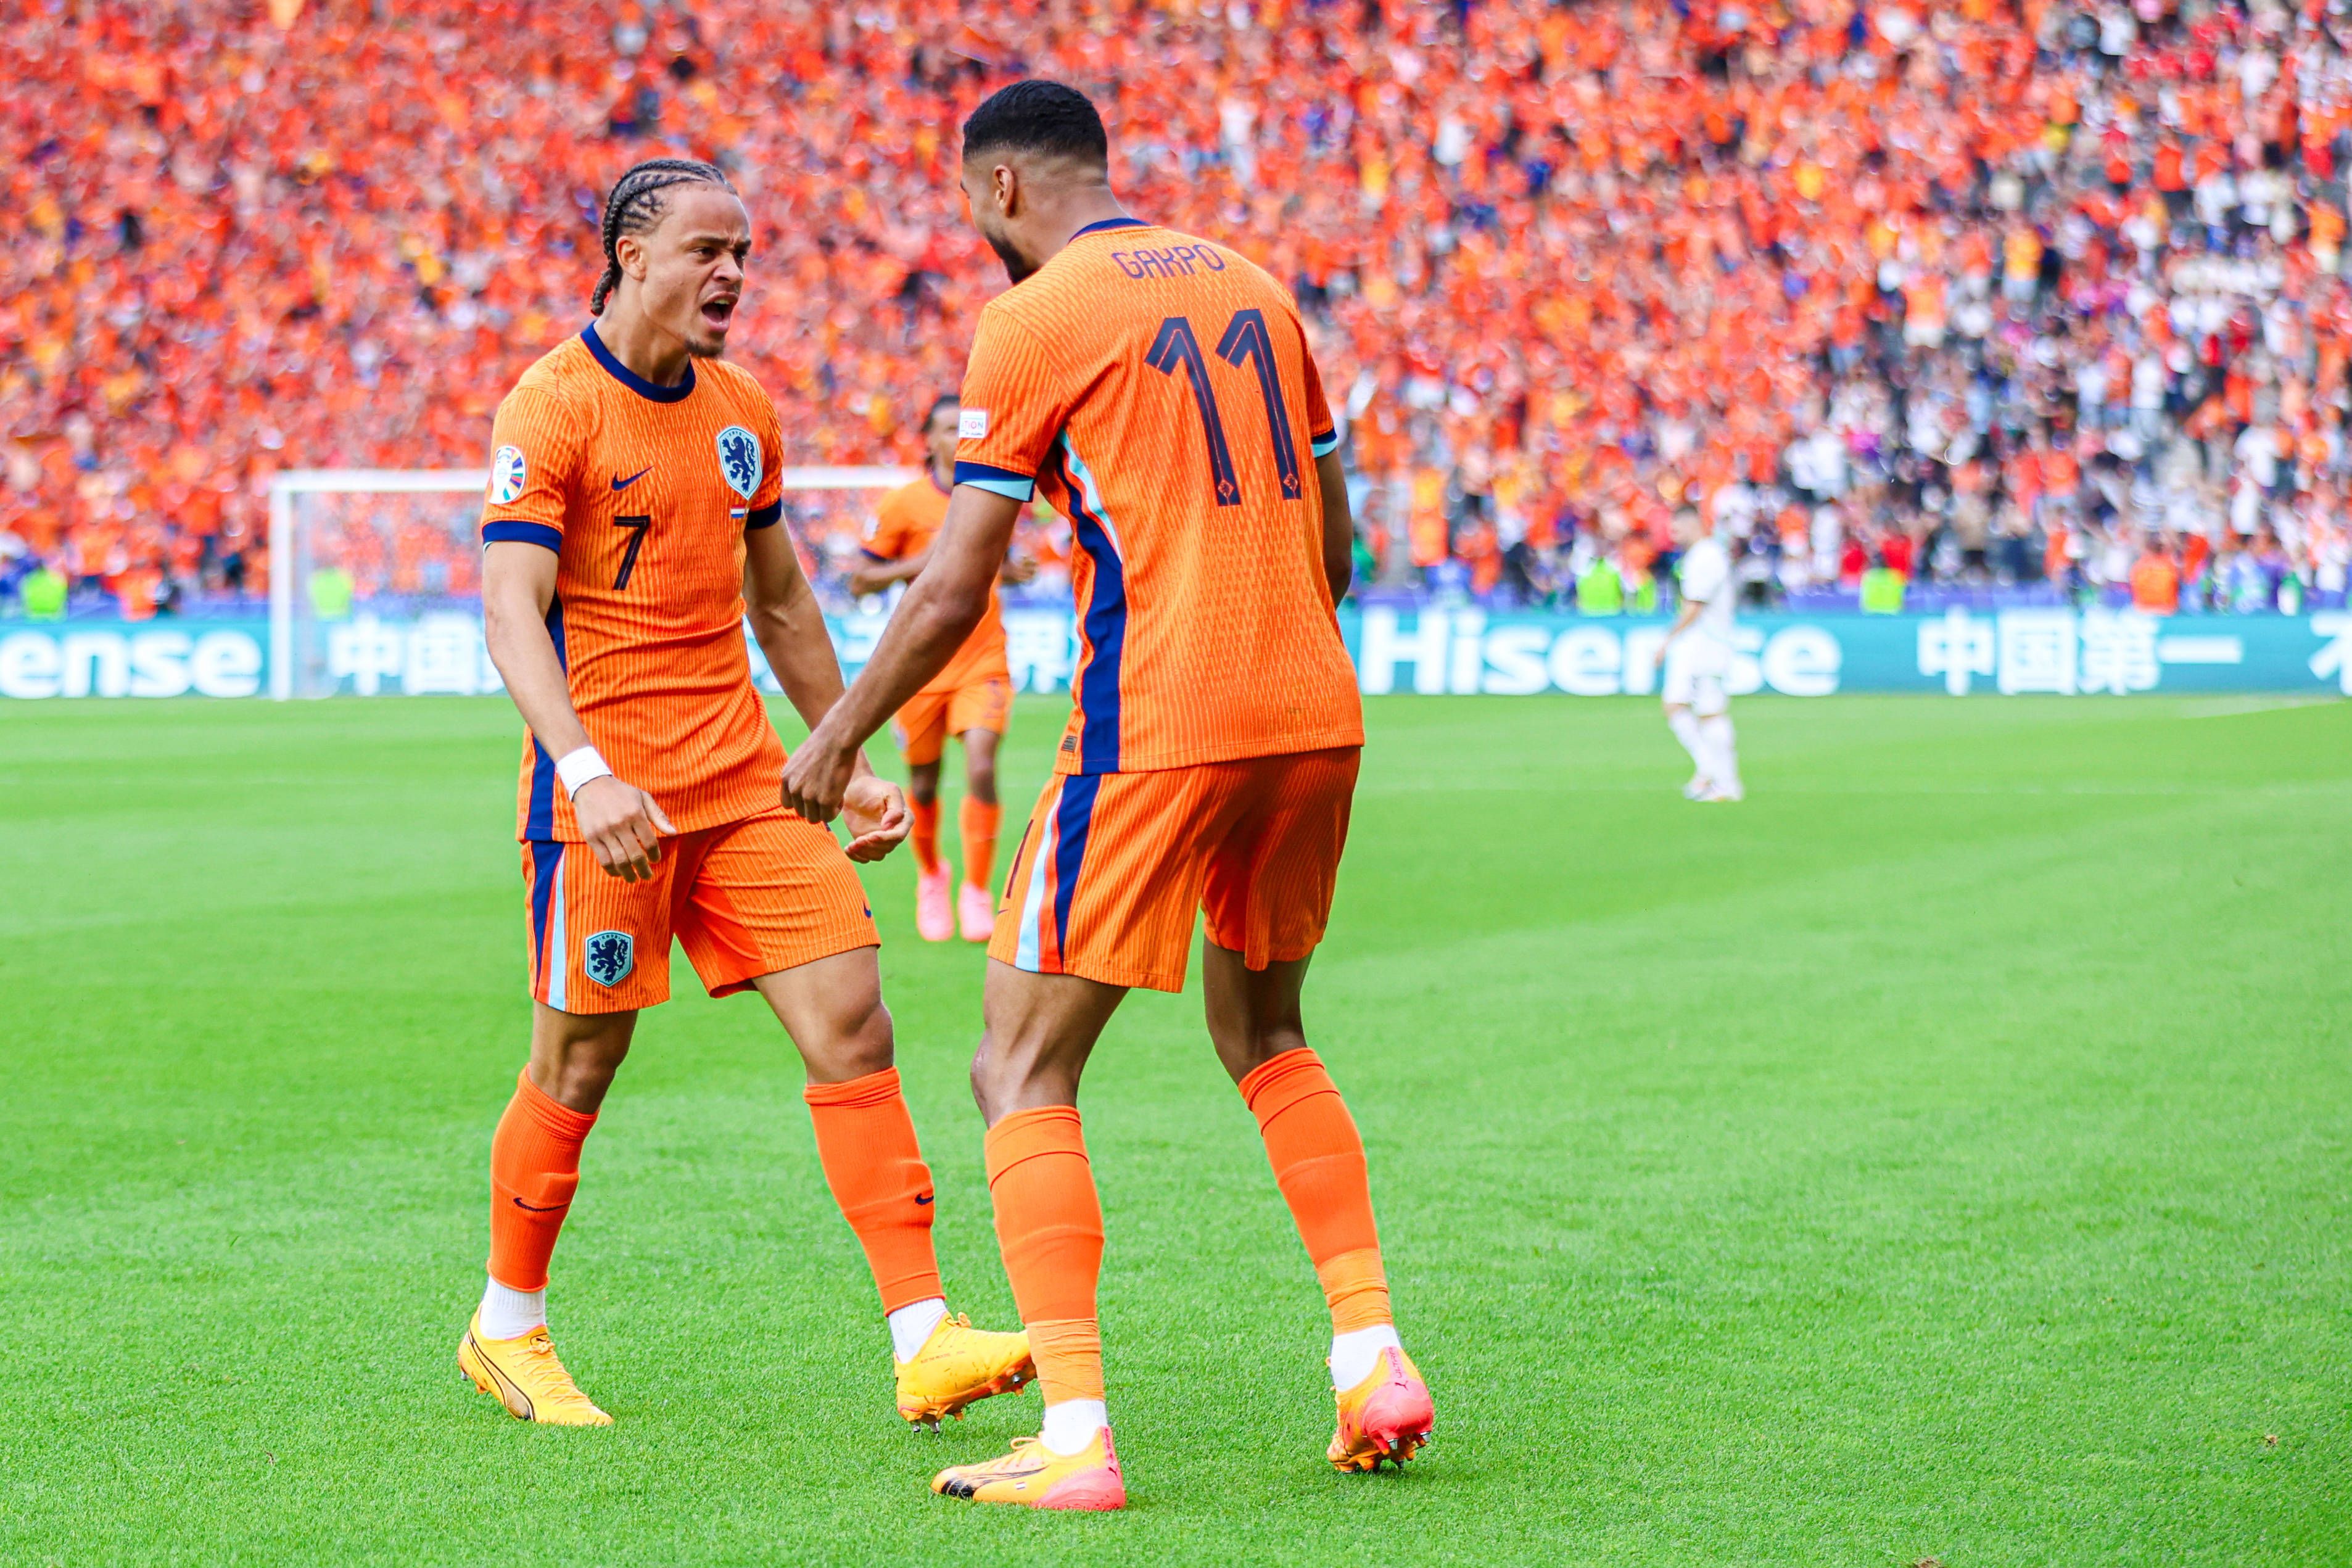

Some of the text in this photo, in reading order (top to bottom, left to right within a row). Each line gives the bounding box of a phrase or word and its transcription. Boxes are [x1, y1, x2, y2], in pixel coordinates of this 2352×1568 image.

[1111, 244, 1226, 279] GAKPO
[1144, 308, 1302, 507] 11
[613, 514, 651, 591] 7
[1917, 605, 2244, 696] 中国第一
